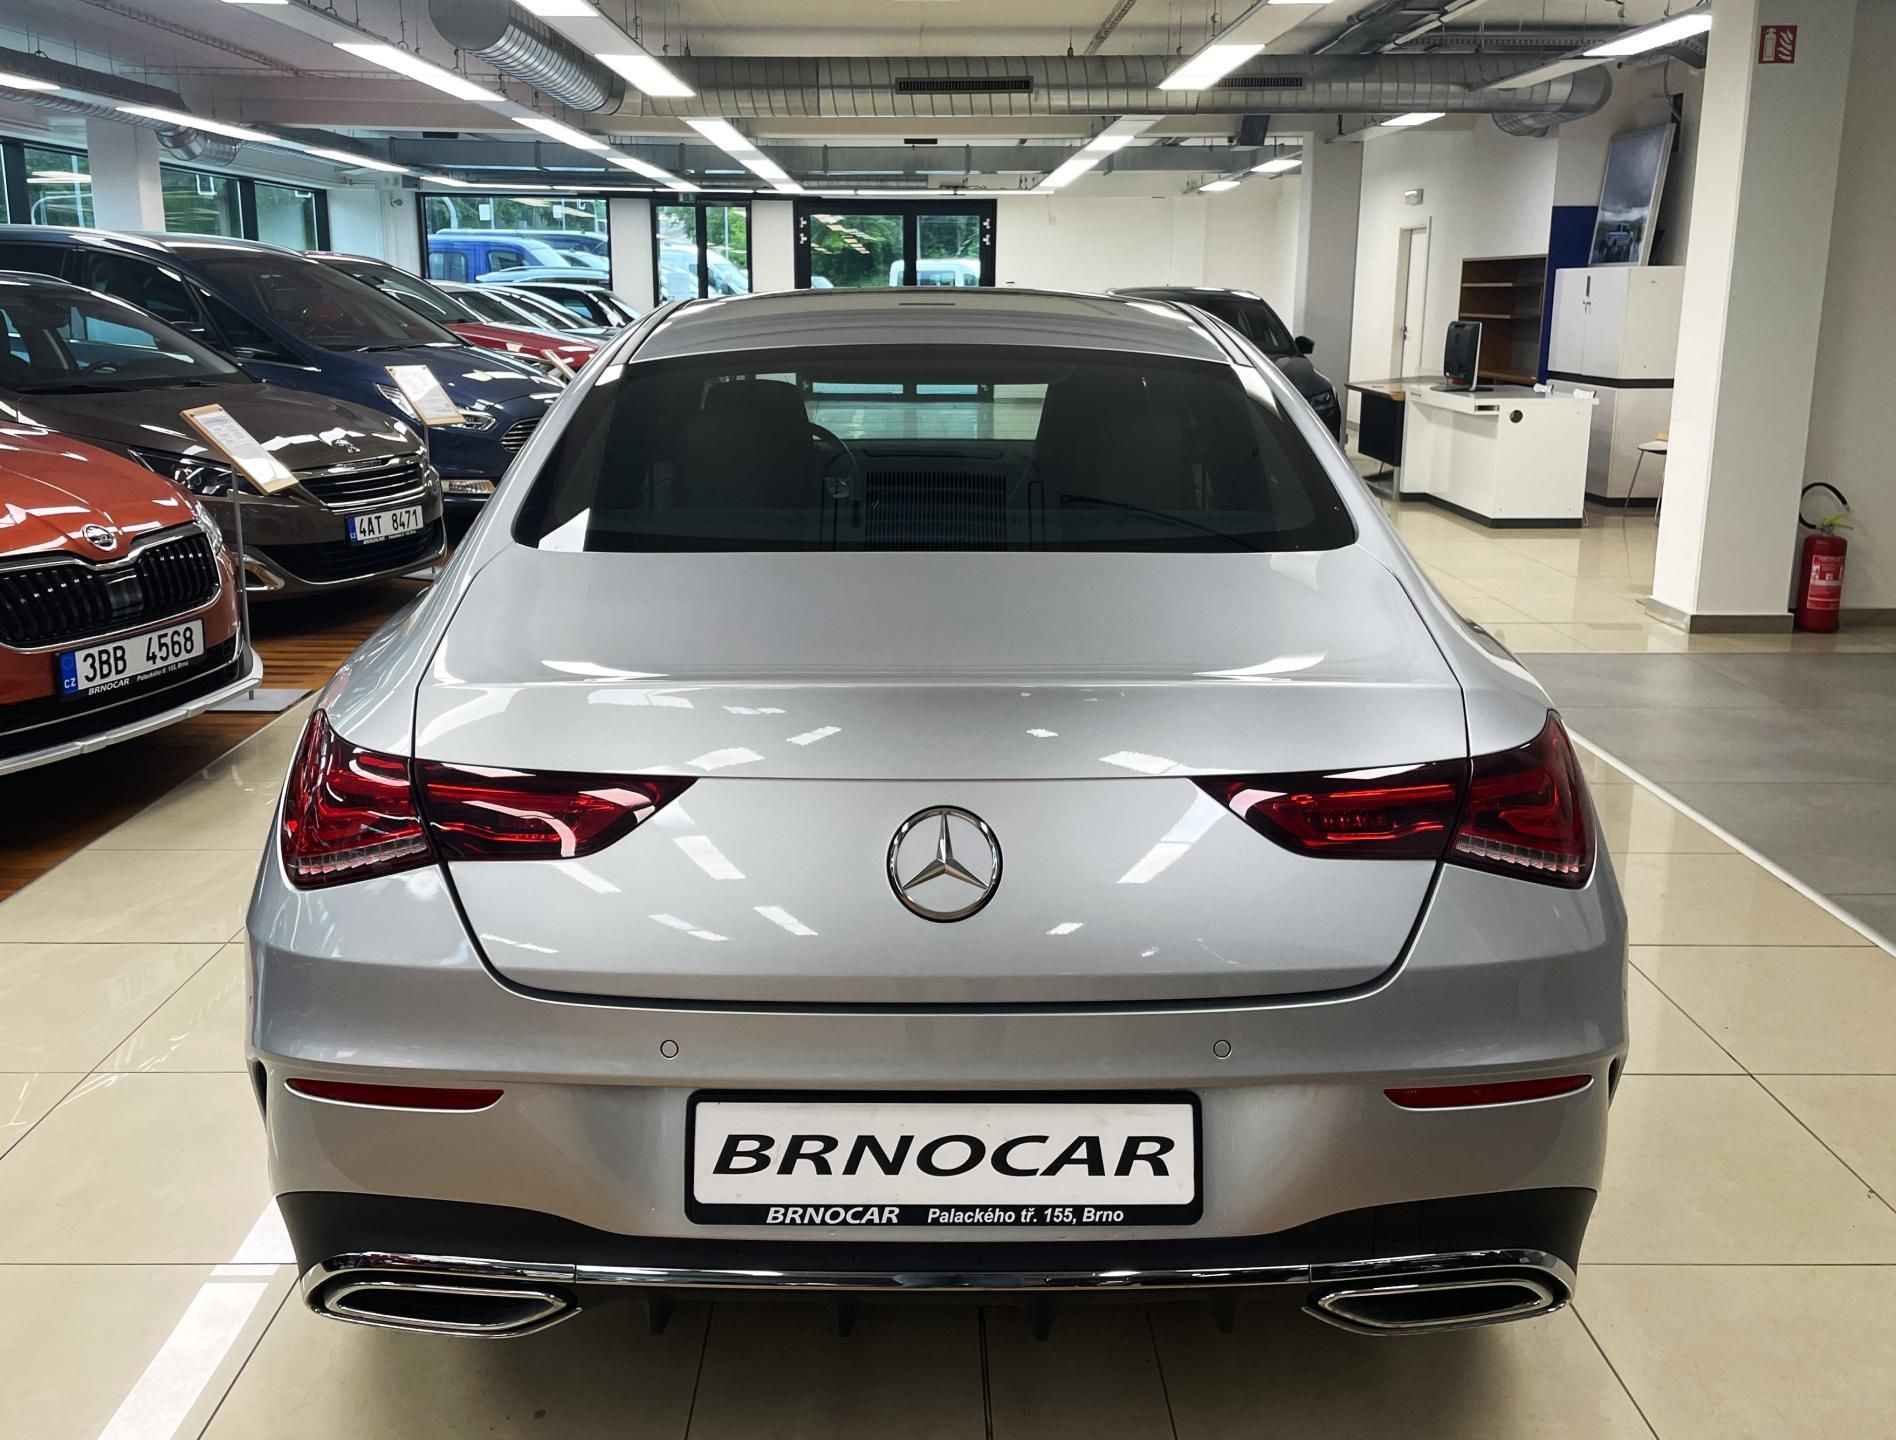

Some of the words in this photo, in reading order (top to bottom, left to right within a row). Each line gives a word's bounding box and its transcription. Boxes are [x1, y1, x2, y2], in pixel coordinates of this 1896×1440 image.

[360, 516, 382, 537] 4AT
[391, 509, 418, 531] 8471
[83, 645, 127, 683] 3BB
[146, 626, 194, 665] 4568
[64, 678, 76, 689] CZ
[88, 678, 130, 696] BRNOCAR
[712, 1134, 1175, 1177] BRNOCAR
[766, 1207, 899, 1224] BRNOCAR
[927, 1208, 1015, 1223] Palackého
[1020, 1207, 1038, 1223] tř.
[1043, 1208, 1077, 1225] 155,
[1082, 1208, 1124, 1222] Brno
